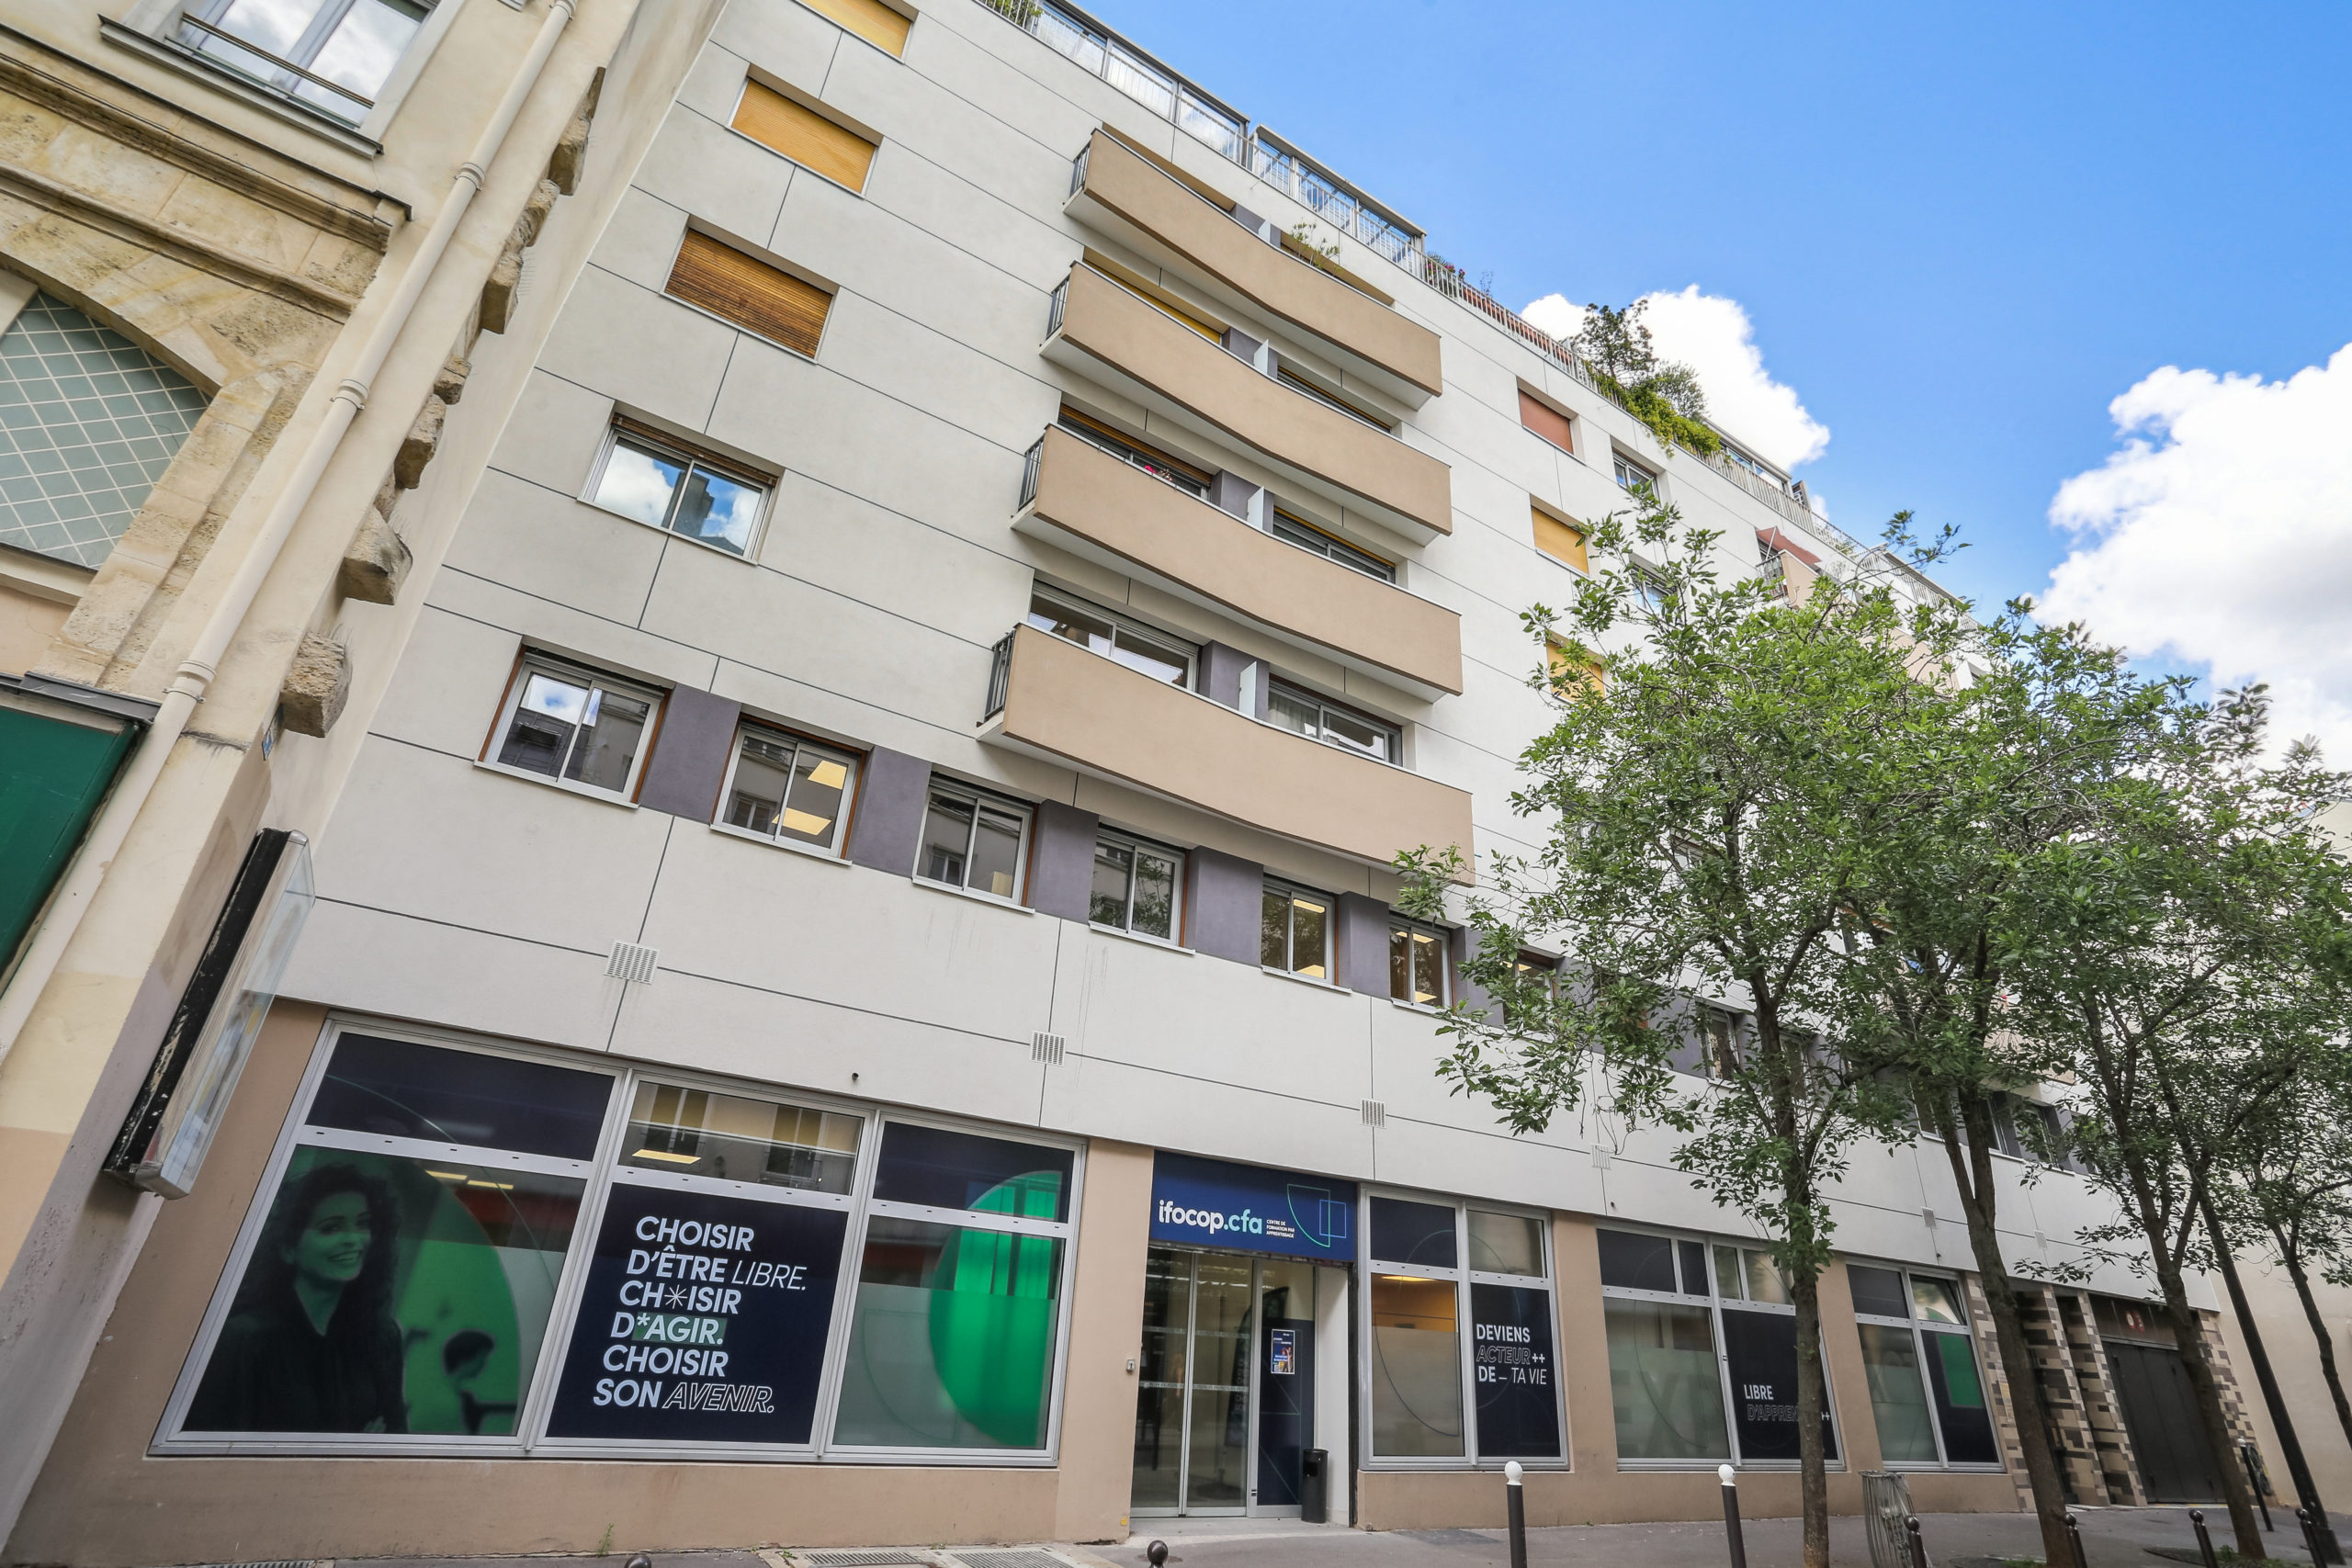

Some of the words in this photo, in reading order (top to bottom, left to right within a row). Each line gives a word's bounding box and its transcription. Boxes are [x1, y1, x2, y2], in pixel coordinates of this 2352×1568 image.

[1159, 1200, 1262, 1234] ifocop.cfa
[636, 1215, 755, 1252] CHOISIR
[626, 1244, 729, 1283] D'ÊTRE
[730, 1259, 808, 1291] LIBRE.
[1476, 1324, 1531, 1343] DEVIENS
[603, 1344, 729, 1377] CHOISIR
[1476, 1345, 1531, 1365] ACTEUR
[1478, 1366, 1497, 1382] DE
[1511, 1367, 1526, 1383] TA
[1529, 1368, 1547, 1385] VIE
[593, 1378, 663, 1408] SON
[661, 1381, 775, 1414] AVENIR.
[1744, 1384, 1774, 1400] LIBRE
[1747, 1404, 1799, 1422] D'APPREN
